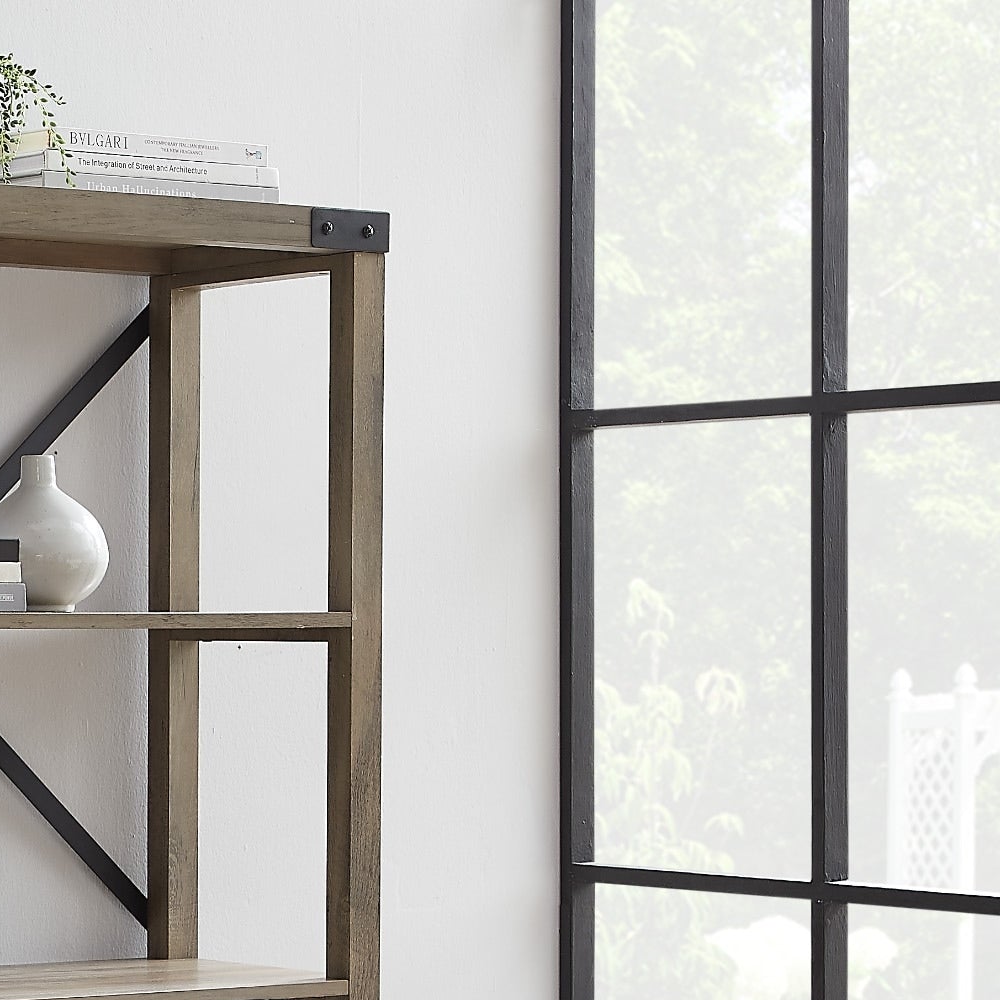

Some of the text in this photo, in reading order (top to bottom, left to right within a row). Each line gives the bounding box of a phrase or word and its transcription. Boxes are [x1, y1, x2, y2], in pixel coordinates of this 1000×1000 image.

[70, 131, 128, 149] BVLGARI
[78, 157, 208, 176] The Integration of Street and Architecture
[86, 181, 198, 198] Urban Hallucinations
